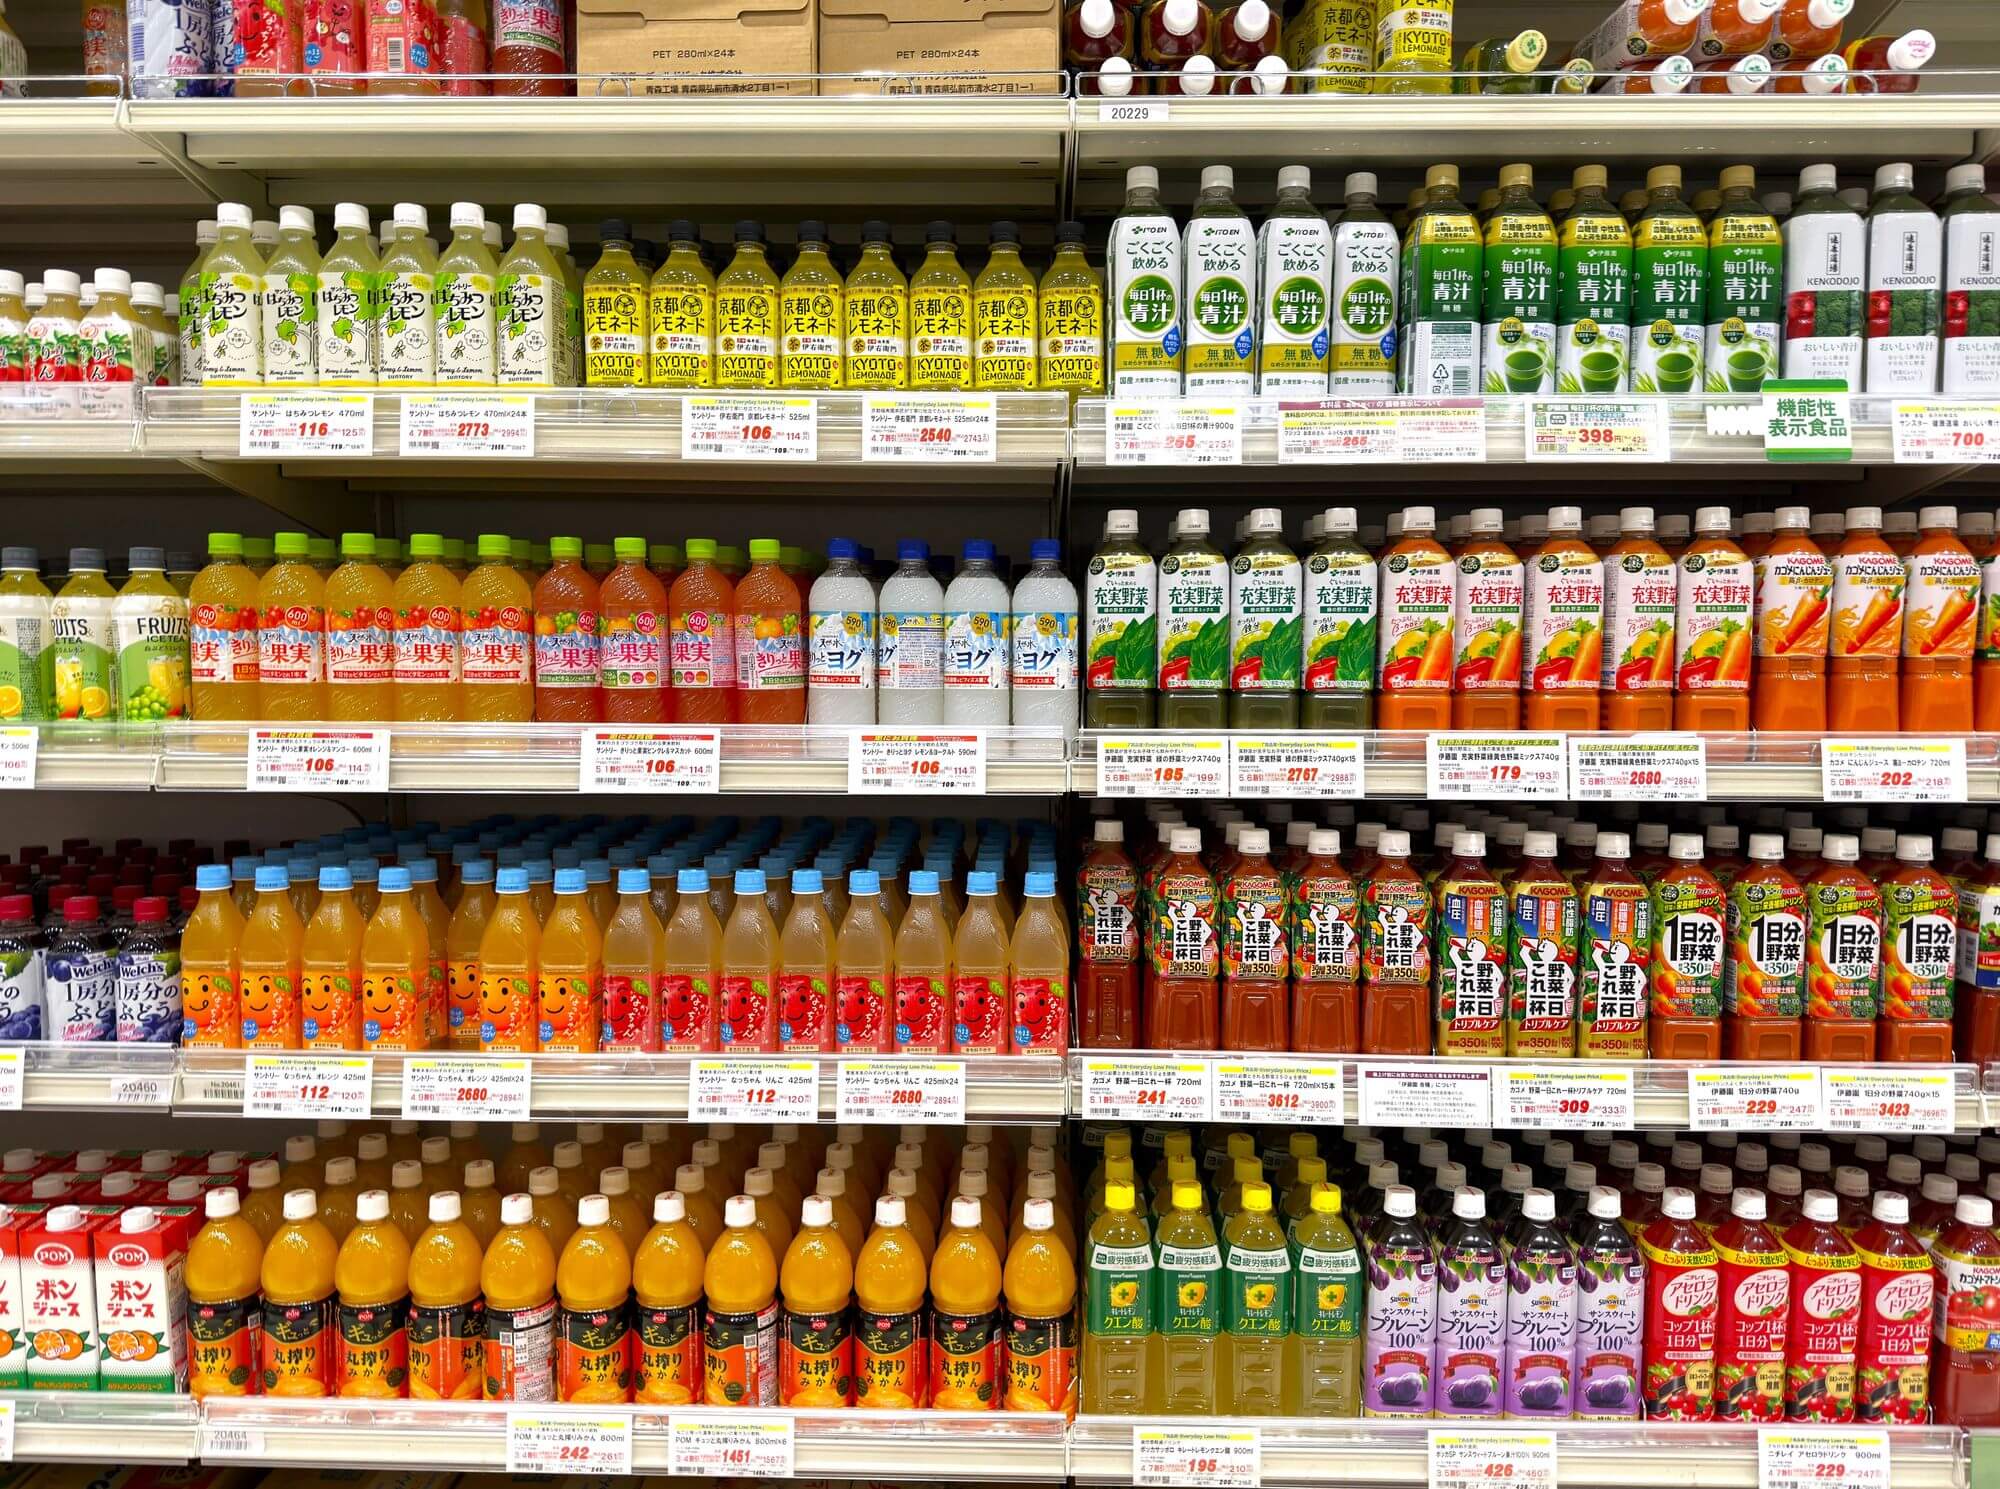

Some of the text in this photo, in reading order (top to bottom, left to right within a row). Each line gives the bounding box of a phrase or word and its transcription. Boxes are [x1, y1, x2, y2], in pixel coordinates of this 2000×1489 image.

[1324, 8, 1352, 26] 京都
[1403, 32, 1446, 47] KYOTO
[653, 50, 671, 59] PET
[896, 50, 915, 59] PET
[1403, 43, 1446, 55] LEMONADE
[1111, 108, 1149, 120] 20229
[1126, 242, 1174, 254] ごくごく
[1132, 258, 1168, 269] 飲める
[1501, 259, 1552, 275] 毎日1杯の
[1723, 260, 1774, 275] 毎日1杯の
[1807, 277, 1859, 285] KENKODOJO
[1883, 276, 1936, 285] KENKODOJO
[1129, 288, 1172, 301] 毎日1杯の
[1502, 277, 1549, 300] 青汁
[1724, 277, 1772, 300] 青汁
[437, 291, 485, 307] はちみつ
[499, 292, 543, 307] はちみつ
[1279, 290, 1322, 303] 毎日1杯の
[586, 296, 612, 314] 京都
[914, 299, 940, 316] 京都
[1515, 306, 1537, 316] 無糖
[449, 308, 485, 321] レモン
[511, 308, 544, 321] レモン
[1130, 303, 1171, 322] 青汁
[1279, 305, 1321, 324] 青汁
[587, 316, 639, 333] レモネード
[914, 319, 966, 335] レモネード
[1136, 348, 1163, 359] 無糖
[590, 357, 633, 368] KYOTO
[918, 359, 961, 371] KYOTO
[591, 369, 634, 377] LEMONADE
[918, 371, 961, 380] LEMONADE
[1776, 399, 1837, 417] 機能性
[299, 422, 328, 436] 116
[457, 423, 489, 437] 2773
[742, 426, 771, 439] 106
[1768, 419, 1847, 437] 表示食品
[920, 428, 950, 442] 2540
[1579, 429, 1613, 443] 398
[1953, 433, 1984, 446] 700
[1787, 557, 1823, 566] KAGOME
[1858, 557, 1897, 566] KAGOME
[1095, 587, 1148, 605] 充実野菜
[1169, 587, 1223, 605] 充実野菜
[1240, 587, 1296, 605] 充実野菜
[1396, 586, 1452, 604] 充実野菜
[432, 610, 449, 621] 600
[638, 616, 656, 627] 600
[846, 616, 861, 627] 590
[137, 618, 189, 635] FRUITS
[306, 758, 334, 771] 106
[646, 760, 675, 773] 106
[911, 761, 940, 774] 106
[1154, 768, 1183, 781] 185
[1288, 768, 1317, 781] 2767
[1491, 766, 1520, 779] 179
[1630, 772, 1661, 784] 2680
[1881, 772, 1912, 785] 202
[1243, 880, 1273, 888] KAGOME
[1530, 887, 1570, 896] KAGOME
[121, 964, 164, 977] Welch's
[1253, 963, 1269, 973] 350
[1683, 963, 1704, 976] 350
[119, 1003, 170, 1020] ぶどう
[1524, 1020, 1568, 1030] トリプルケア
[1530, 1038, 1551, 1048] 350
[122, 1083, 157, 1092] 20460
[1176, 1078, 1202, 1086] 720ml
[300, 1086, 329, 1098] 112
[457, 1088, 487, 1101] 2680
[746, 1089, 776, 1103] 112
[892, 1090, 922, 1104] 2680
[1137, 1090, 1197, 1105] 241 260
[1267, 1094, 1298, 1108] 3612
[1559, 1100, 1619, 1114] 309 333
[1746, 1101, 1807, 1114] 229 247
[1879, 1103, 1910, 1116] 3423
[40, 1251, 68, 1262] POM
[115, 1251, 143, 1262] POM
[36, 1280, 76, 1300] ポン
[110, 1280, 151, 1301] ポン
[1670, 1277, 1717, 1295] アセロラ
[1742, 1278, 1789, 1296] アセロラ
[1678, 1291, 1715, 1309] ドリンク
[1749, 1292, 1785, 1310] ドリンク
[34, 1302, 80, 1318] ジュース
[108, 1302, 154, 1318] ジュース
[1381, 1308, 1428, 1316] サンスウィート
[1103, 1317, 1143, 1329] クエン酸
[1239, 1319, 1281, 1331] クエン酸
[1371, 1315, 1434, 1332] プルーン
[1388, 1335, 1424, 1348] 100%
[1667, 1335, 1697, 1347] 1日分
[864, 1358, 905, 1377] 丸搾り
[941, 1358, 981, 1377] 丸搾り
[866, 1376, 902, 1387] みかん
[214, 1431, 247, 1440] 20464
[560, 1446, 589, 1459] 242
[723, 1450, 750, 1463] 1451
[1768, 1451, 1793, 1459] ニチレイ
[1189, 1459, 1216, 1472] 195
[1484, 1464, 1513, 1477] 426
[1815, 1465, 1845, 1477] 229
